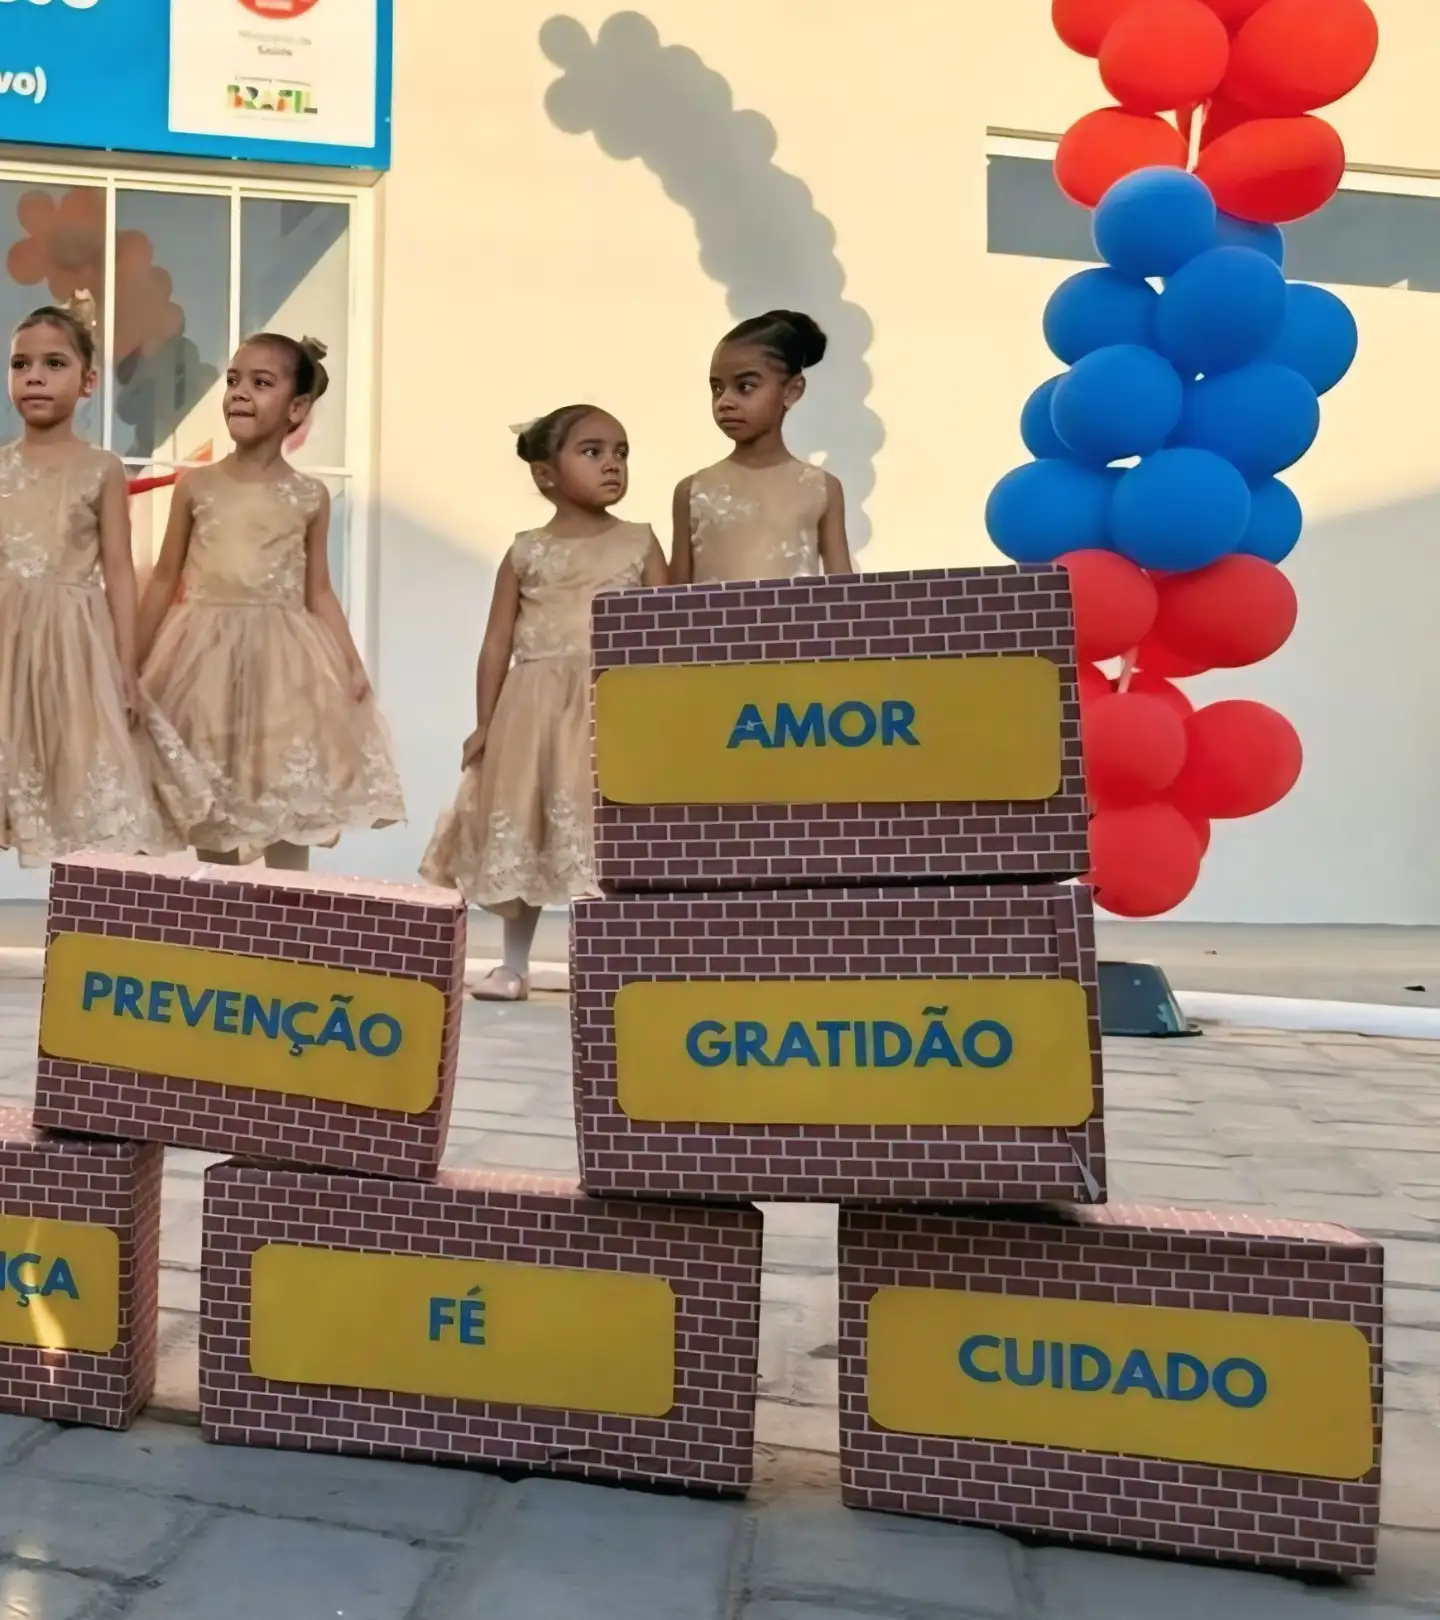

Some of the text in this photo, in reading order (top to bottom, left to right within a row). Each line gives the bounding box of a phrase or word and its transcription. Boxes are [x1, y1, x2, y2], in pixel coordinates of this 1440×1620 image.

[726, 699, 920, 750] AMOR
[81, 971, 403, 1058] PREVENÇÃO
[684, 1004, 1014, 1069] GRATIDÃO
[427, 1286, 486, 1346] FÉ
[956, 1332, 1269, 1411] CUIDADO
